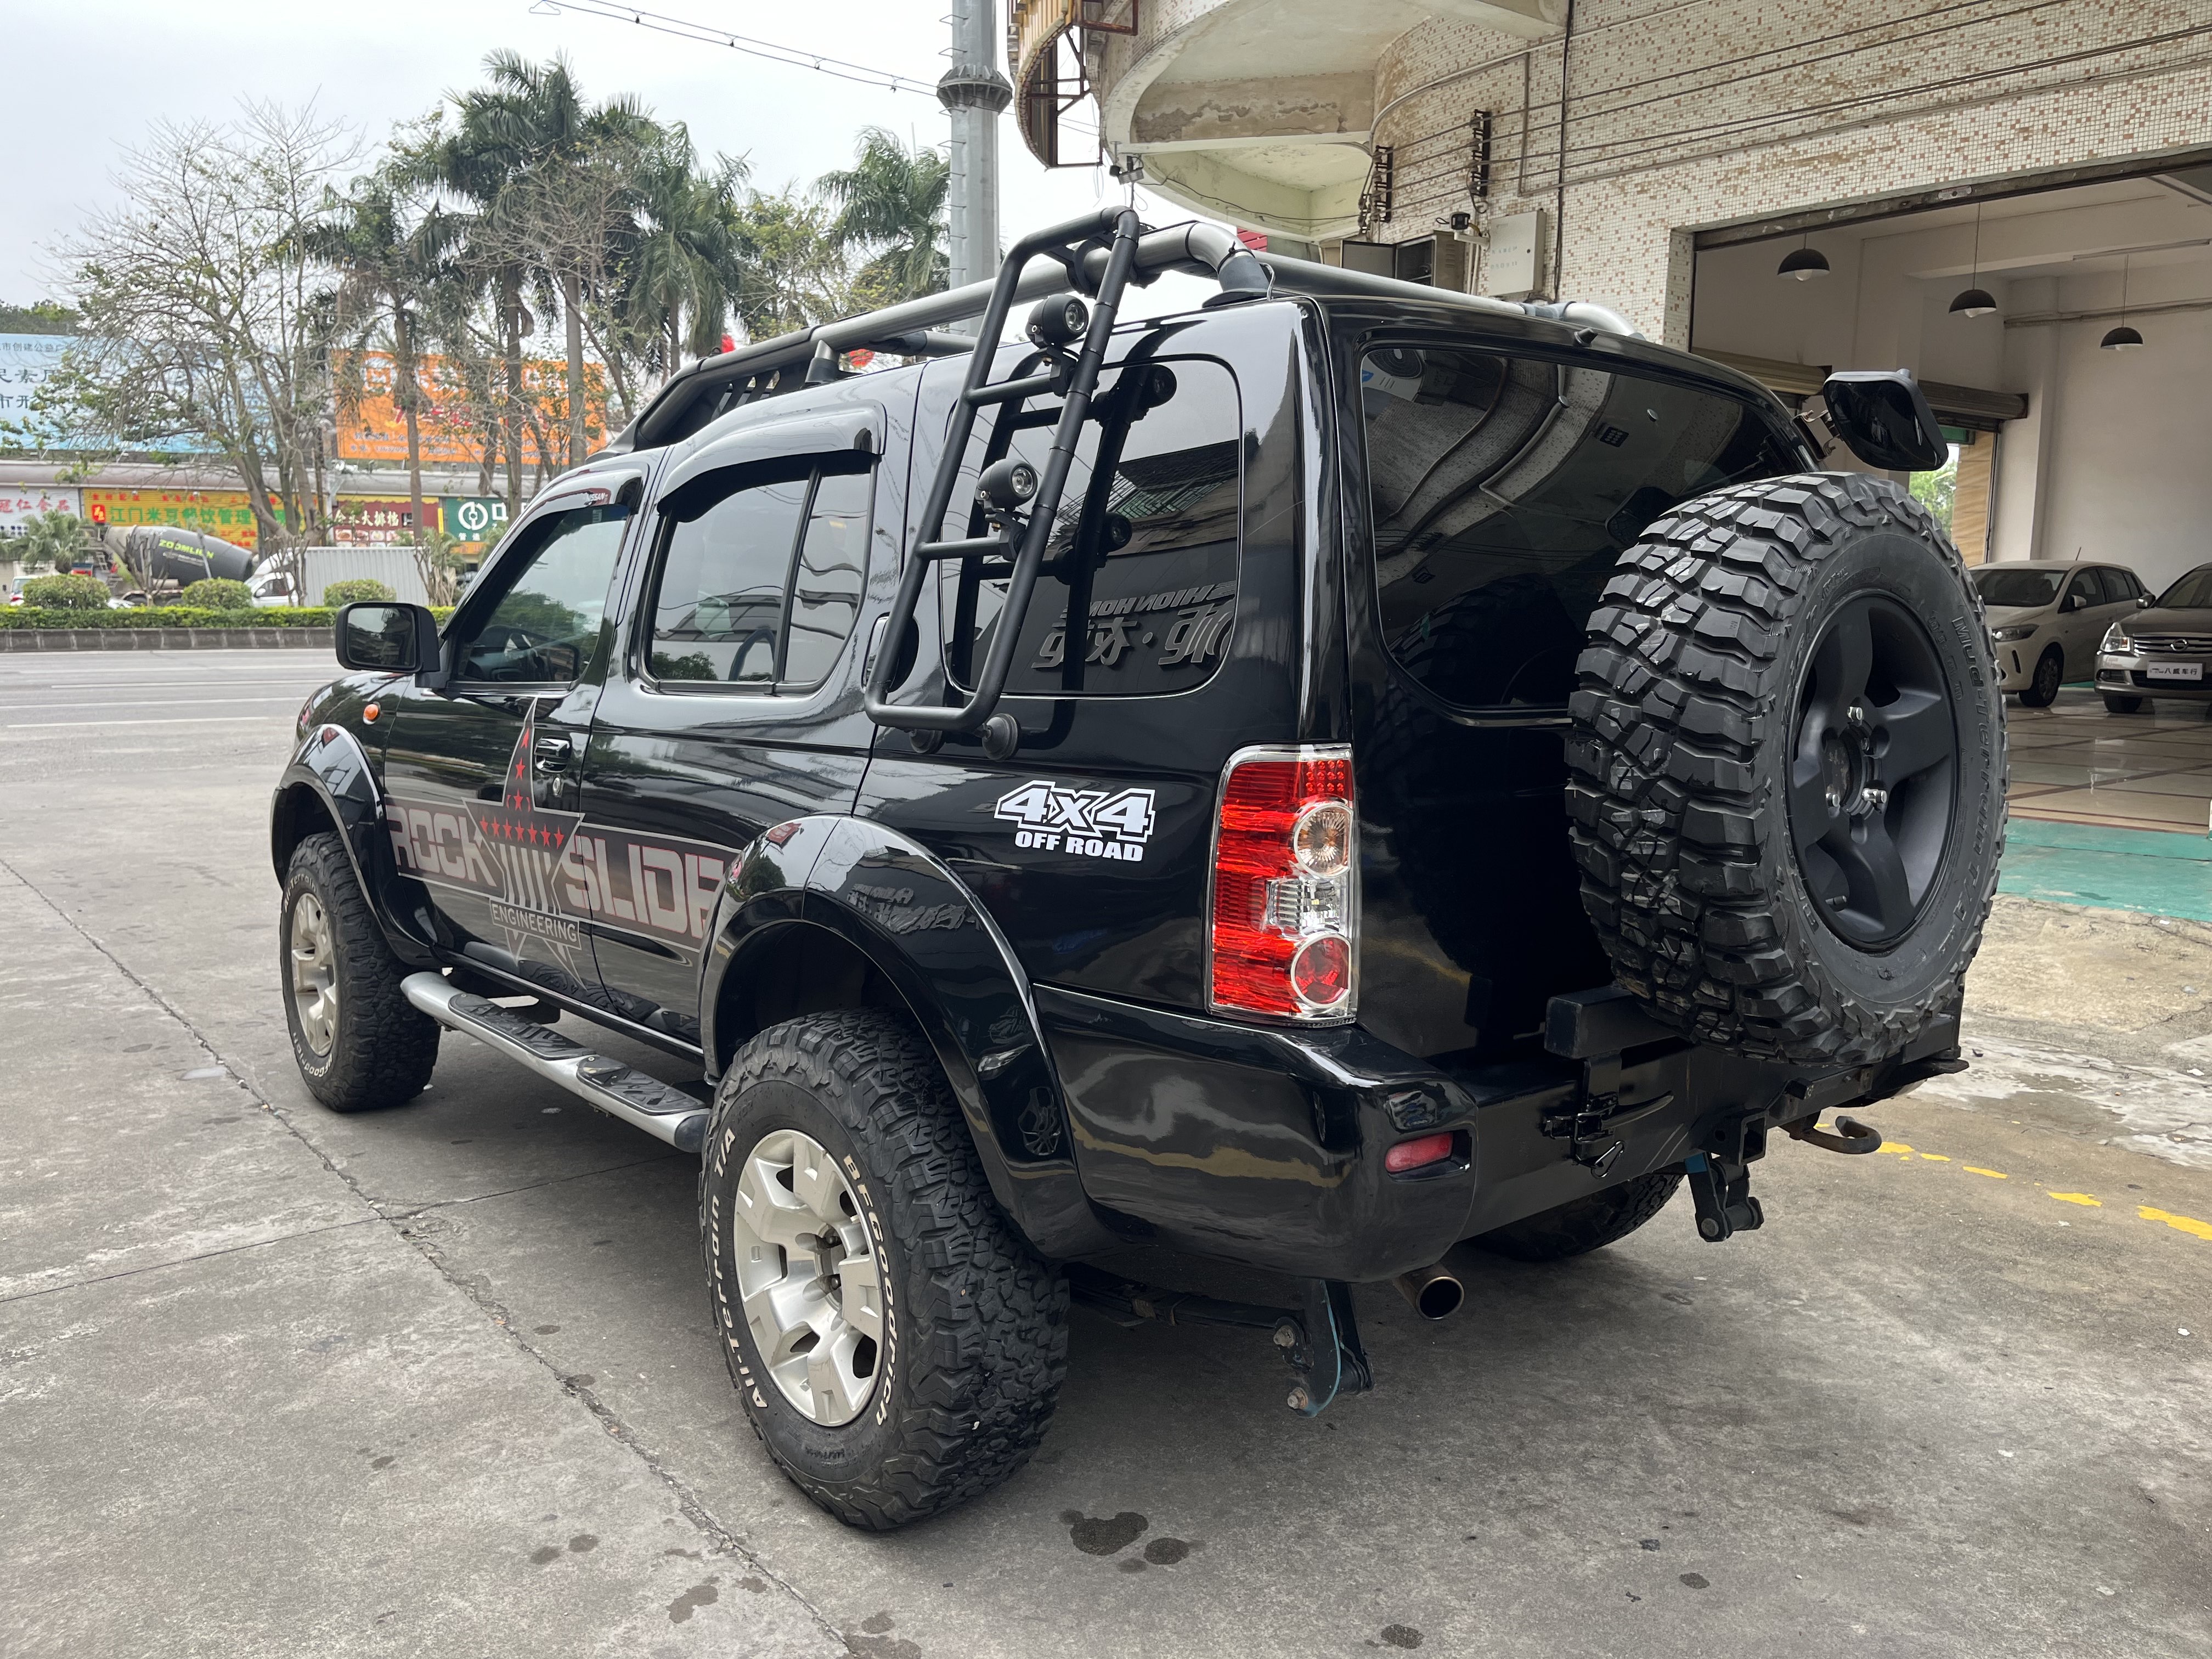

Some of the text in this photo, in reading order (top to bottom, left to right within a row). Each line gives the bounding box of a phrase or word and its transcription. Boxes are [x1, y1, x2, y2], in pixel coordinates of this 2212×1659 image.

[0, 342, 66, 352] 市创建公益广
[110, 507, 286, 525] 江门米豆餐饮管理
[386, 804, 496, 887] ROCK
[1015, 831, 1143, 862] OFF ROAD
[493, 903, 577, 942] ENGINEERING
[712, 1127, 768, 1408] All-Terrain T/A
[843, 1154, 898, 1425] BFGoodrich
